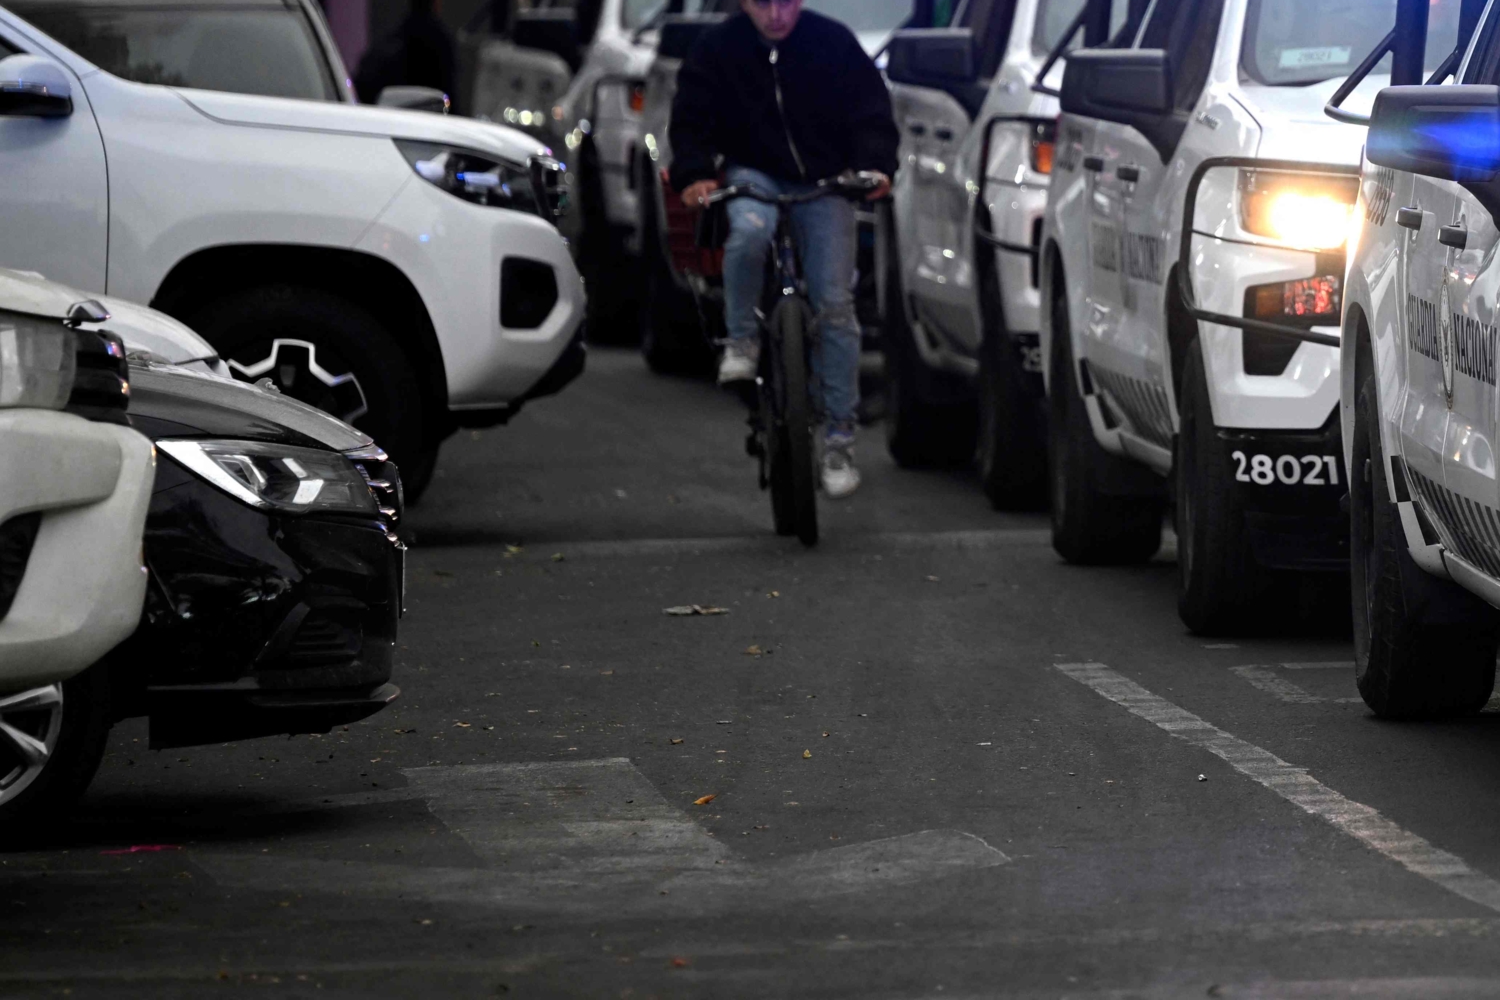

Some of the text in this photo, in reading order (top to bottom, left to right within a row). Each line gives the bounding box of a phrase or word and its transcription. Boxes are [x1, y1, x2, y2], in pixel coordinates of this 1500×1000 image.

[1407, 292, 1498, 387] GUARDIA NACIONAL
[1233, 450, 1339, 486] 28021
